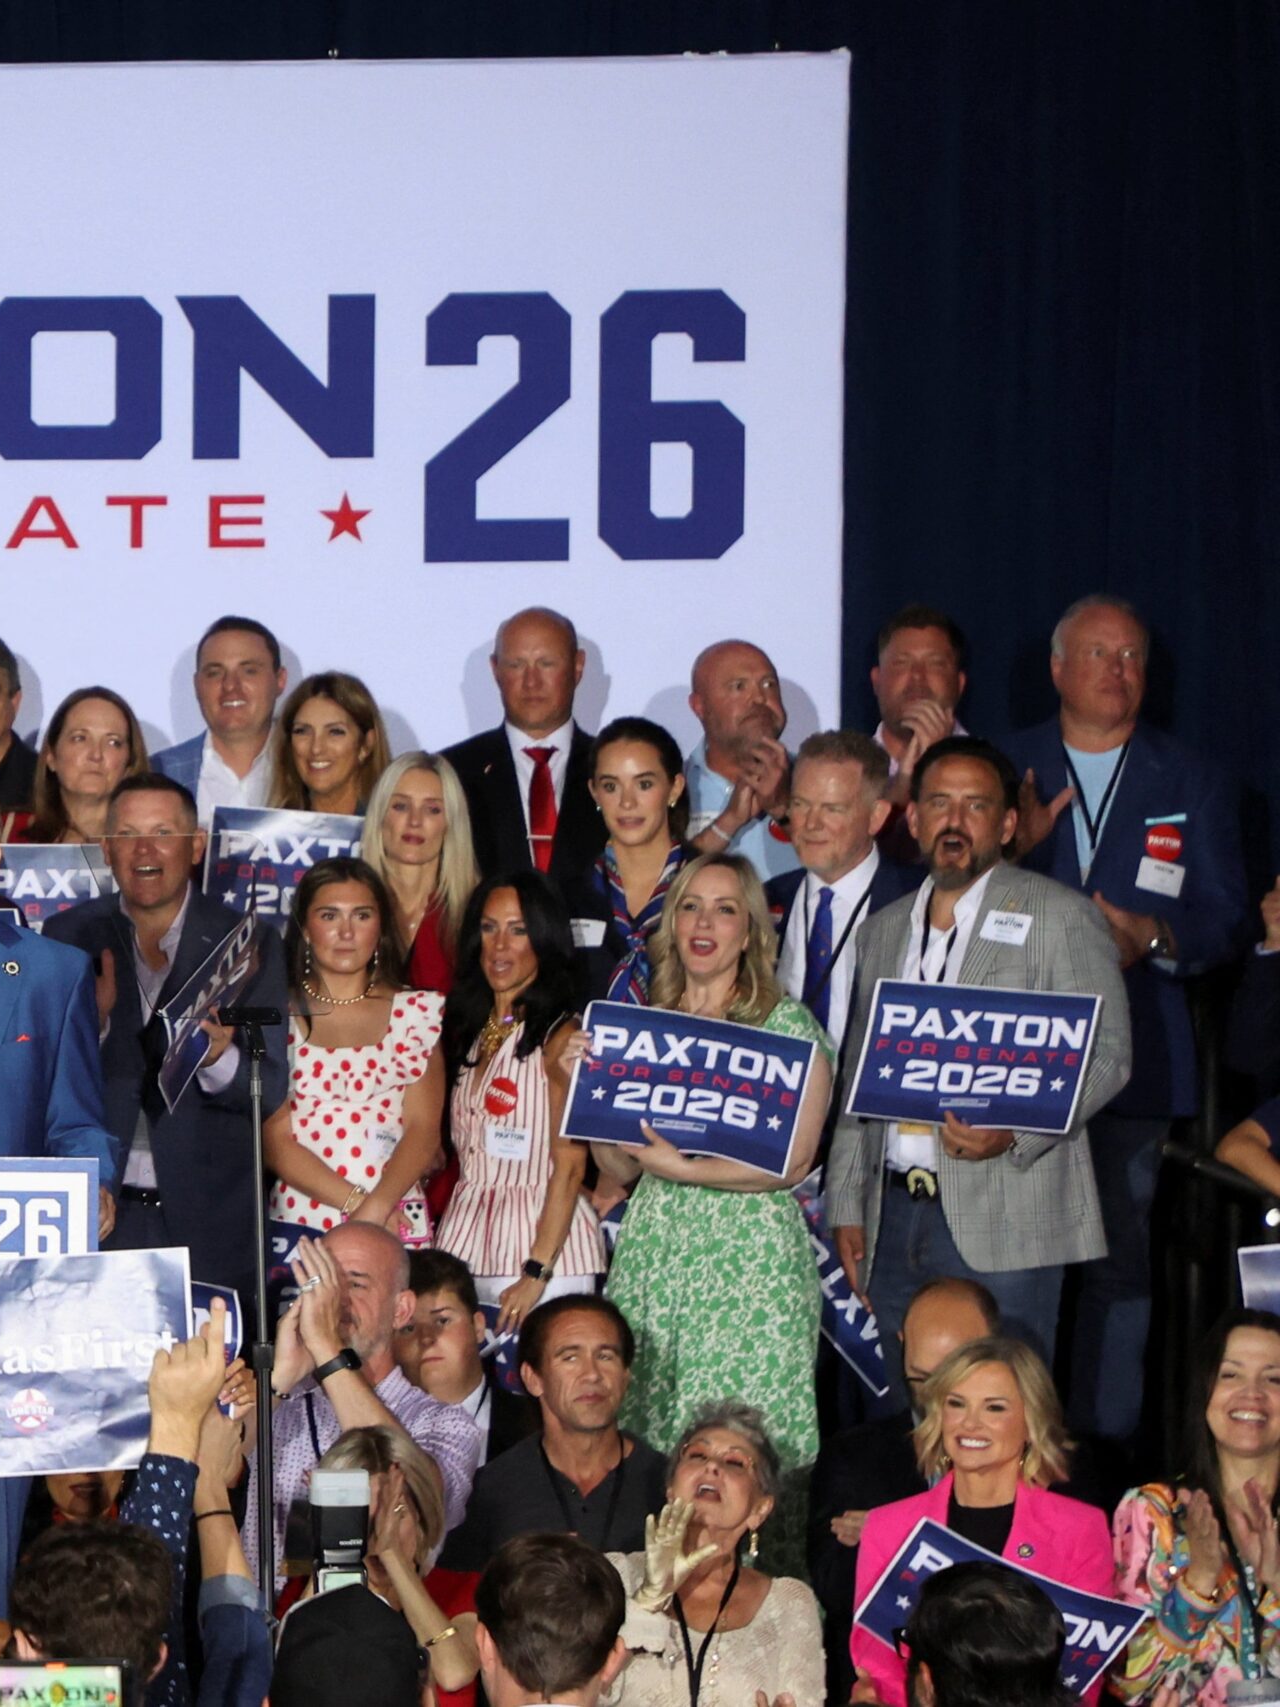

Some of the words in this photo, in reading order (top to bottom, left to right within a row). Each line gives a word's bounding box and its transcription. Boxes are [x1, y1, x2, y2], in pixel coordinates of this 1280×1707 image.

[423, 289, 746, 562] 26
[219, 829, 361, 867] PAXT
[879, 1004, 1088, 1050] PAXTON
[591, 1024, 804, 1091] PAXTON
[875, 1038, 938, 1057] FOR
[955, 1045, 1081, 1067] SENATE
[587, 1060, 651, 1079] FOR
[669, 1069, 797, 1107] SENATE
[901, 1059, 1043, 1098] 2026
[612, 1080, 761, 1130] 2026
